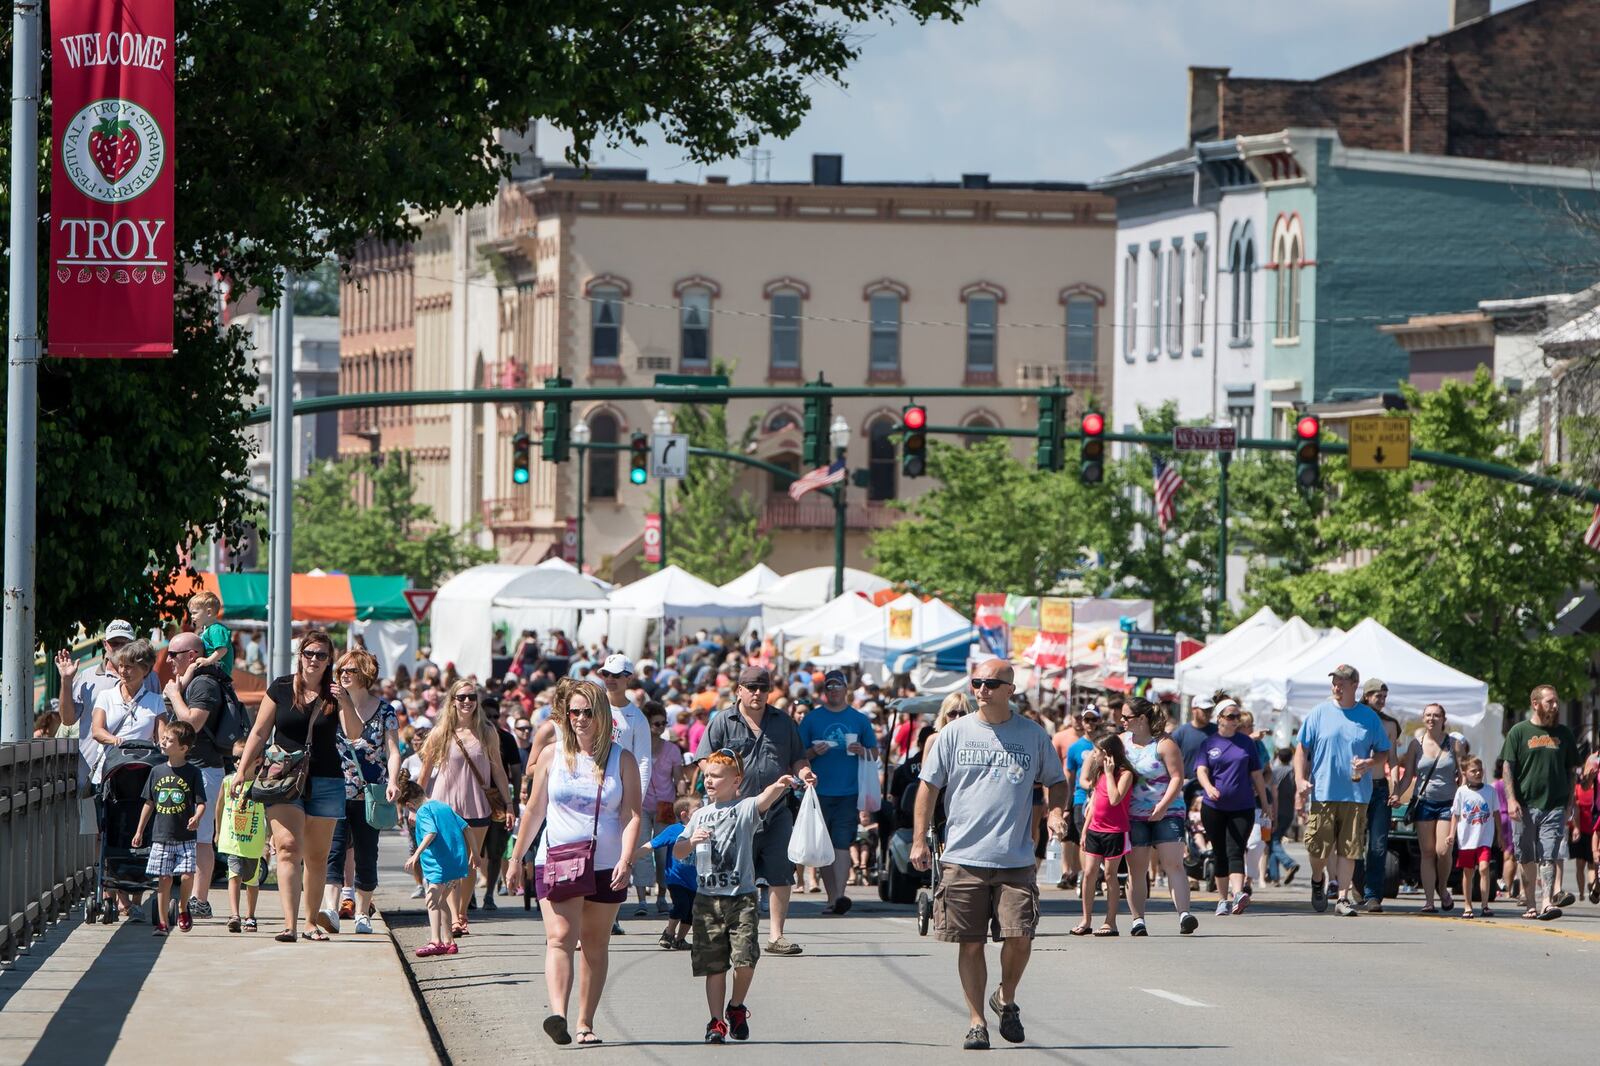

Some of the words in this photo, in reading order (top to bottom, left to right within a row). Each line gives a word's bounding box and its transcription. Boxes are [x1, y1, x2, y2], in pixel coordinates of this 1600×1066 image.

[61, 32, 166, 71] WELCOME
[89, 102, 132, 116] TROY
[65, 123, 97, 193] FESTIVAL
[102, 114, 160, 198] STRAWBERRY
[60, 219, 166, 259] TROY
[957, 749, 1031, 771] CHAMPIONS
[154, 775, 175, 792] EVERY
[177, 777, 191, 792] DAY
[698, 810, 724, 825] LIKE
